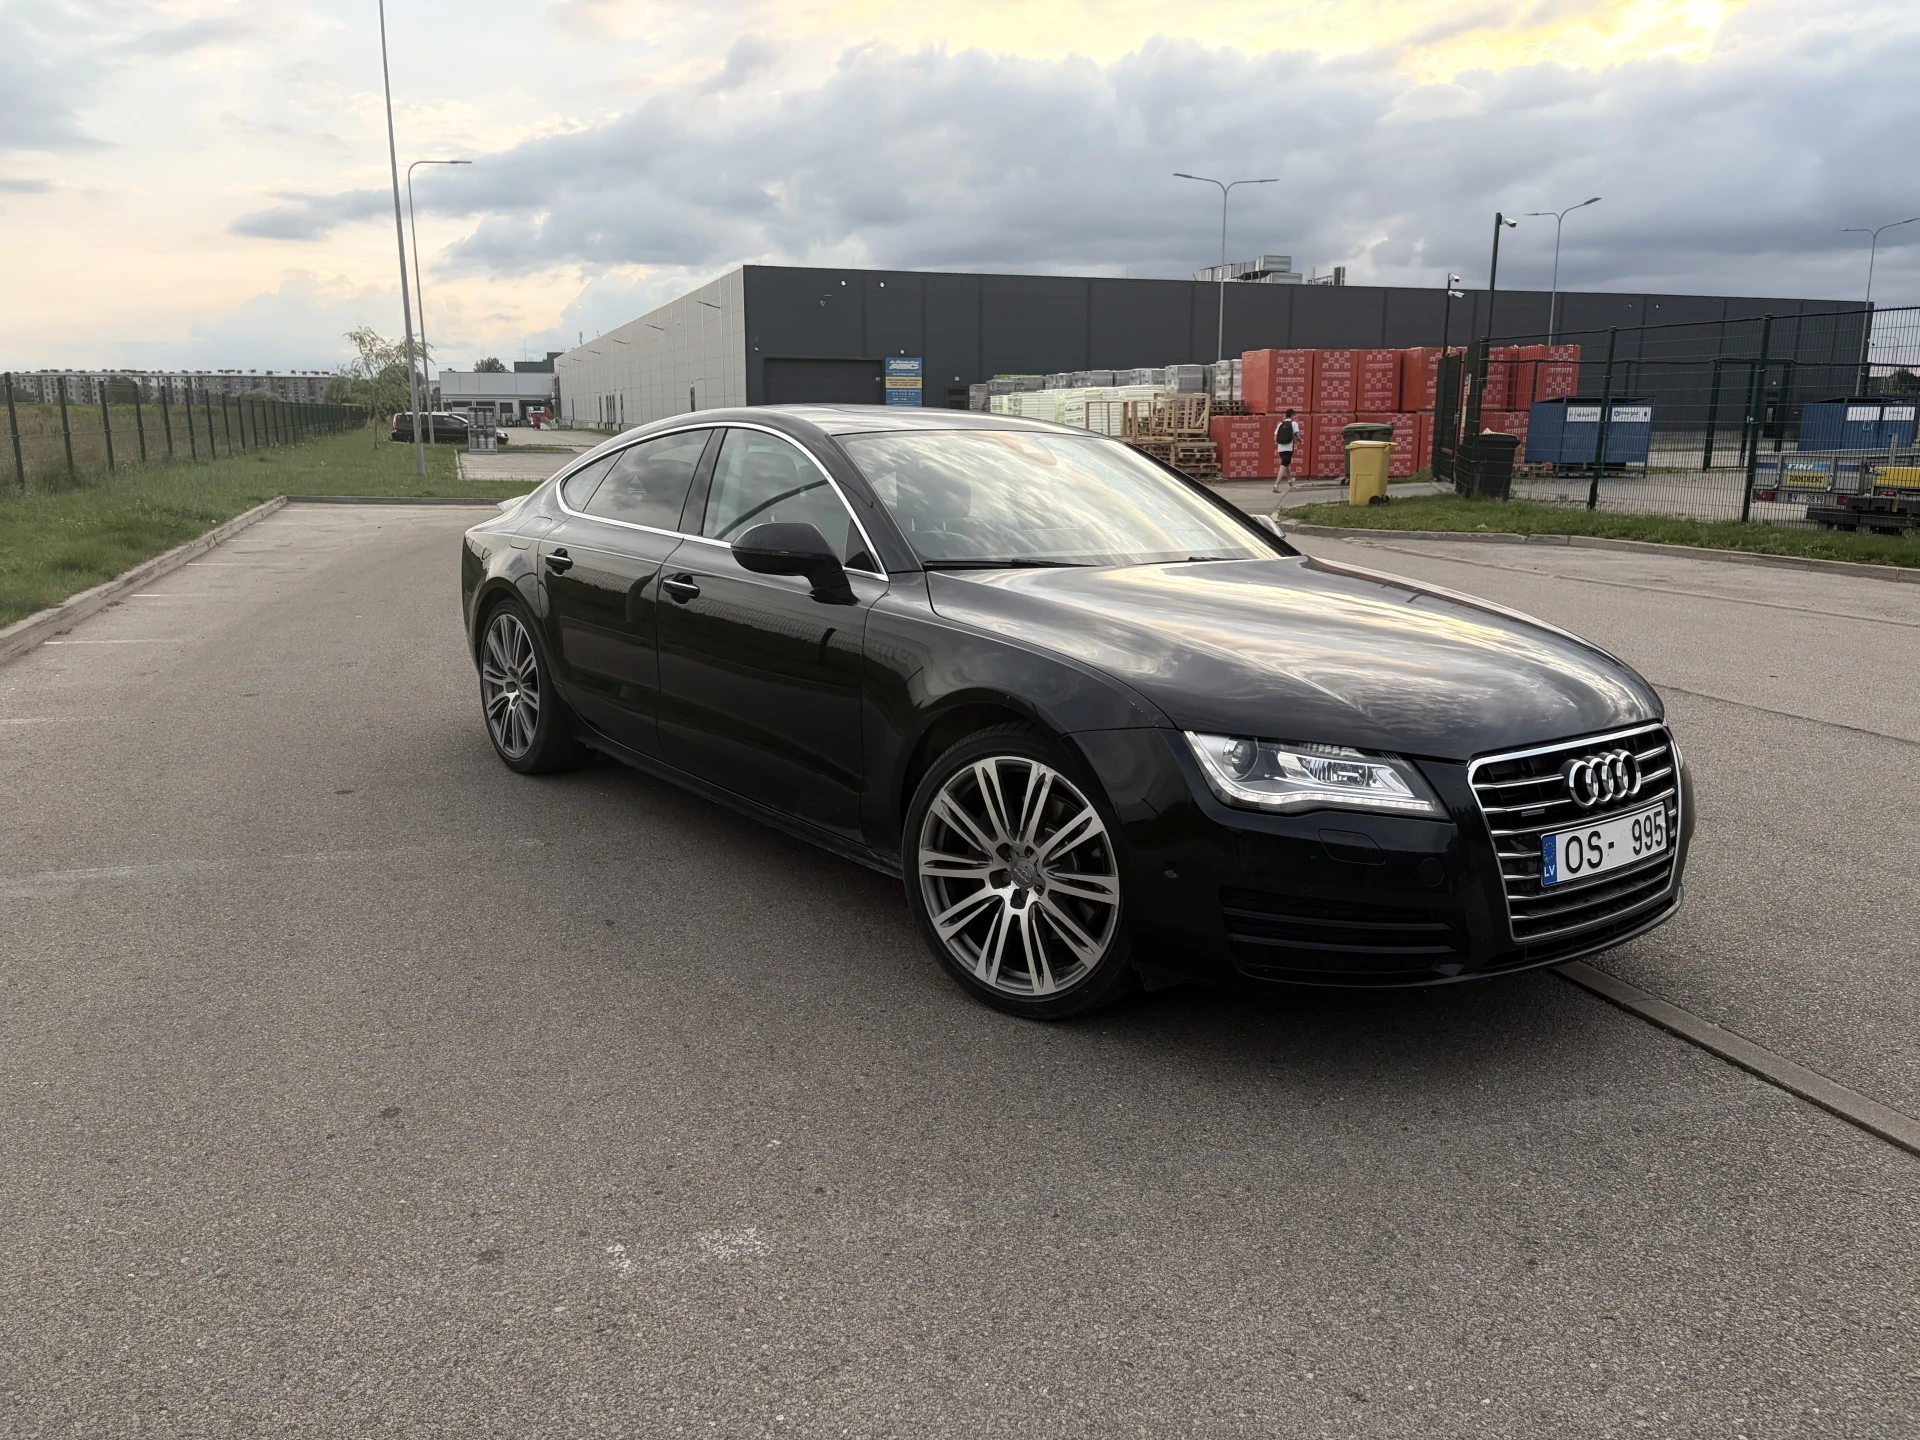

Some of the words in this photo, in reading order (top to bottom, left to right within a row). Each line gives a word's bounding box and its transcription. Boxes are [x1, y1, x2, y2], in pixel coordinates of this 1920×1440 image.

[1789, 475, 1824, 483] RAMIRENT
[1632, 809, 1664, 855] 995
[1544, 865, 1555, 877] LV
